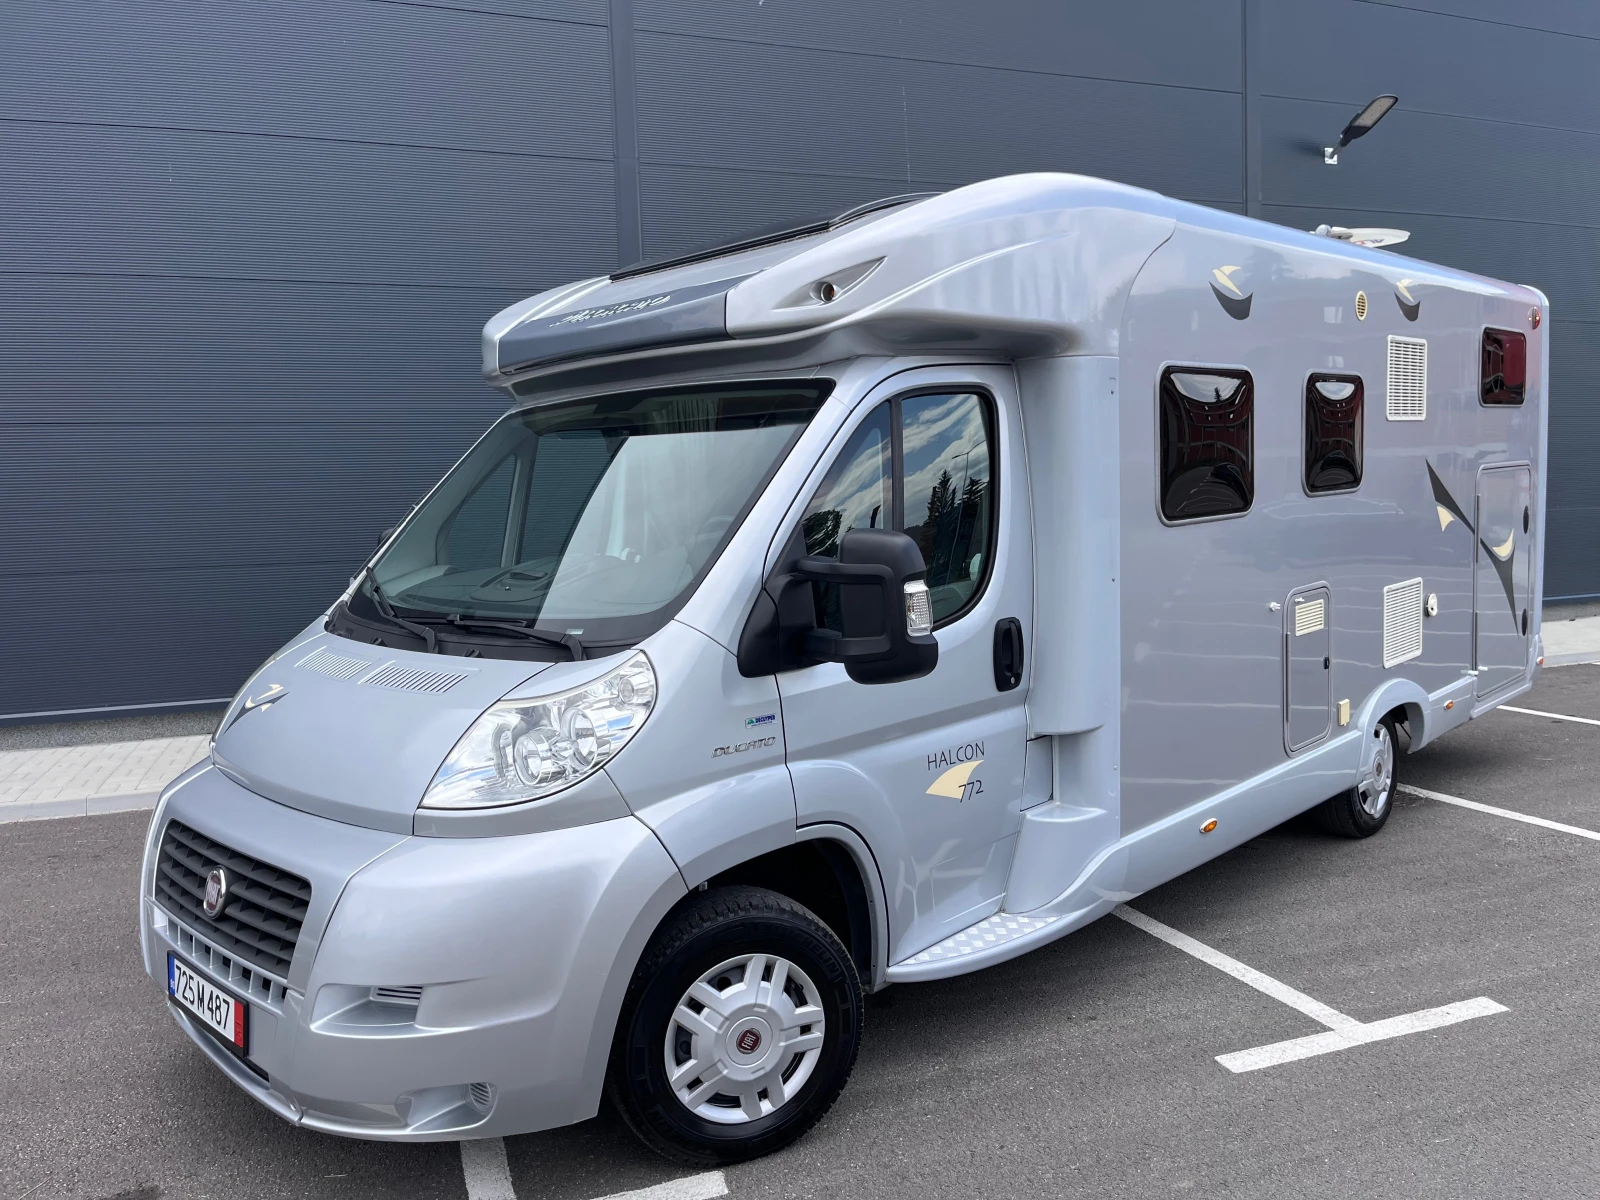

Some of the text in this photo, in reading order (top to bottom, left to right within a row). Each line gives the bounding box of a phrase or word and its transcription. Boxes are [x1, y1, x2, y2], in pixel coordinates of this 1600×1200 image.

[711, 736, 776, 758] DUCATO
[927, 741, 985, 771] HALCON
[958, 779, 984, 803] 772
[175, 964, 230, 1030] 725 M 487
[741, 1032, 757, 1050] FIAT
